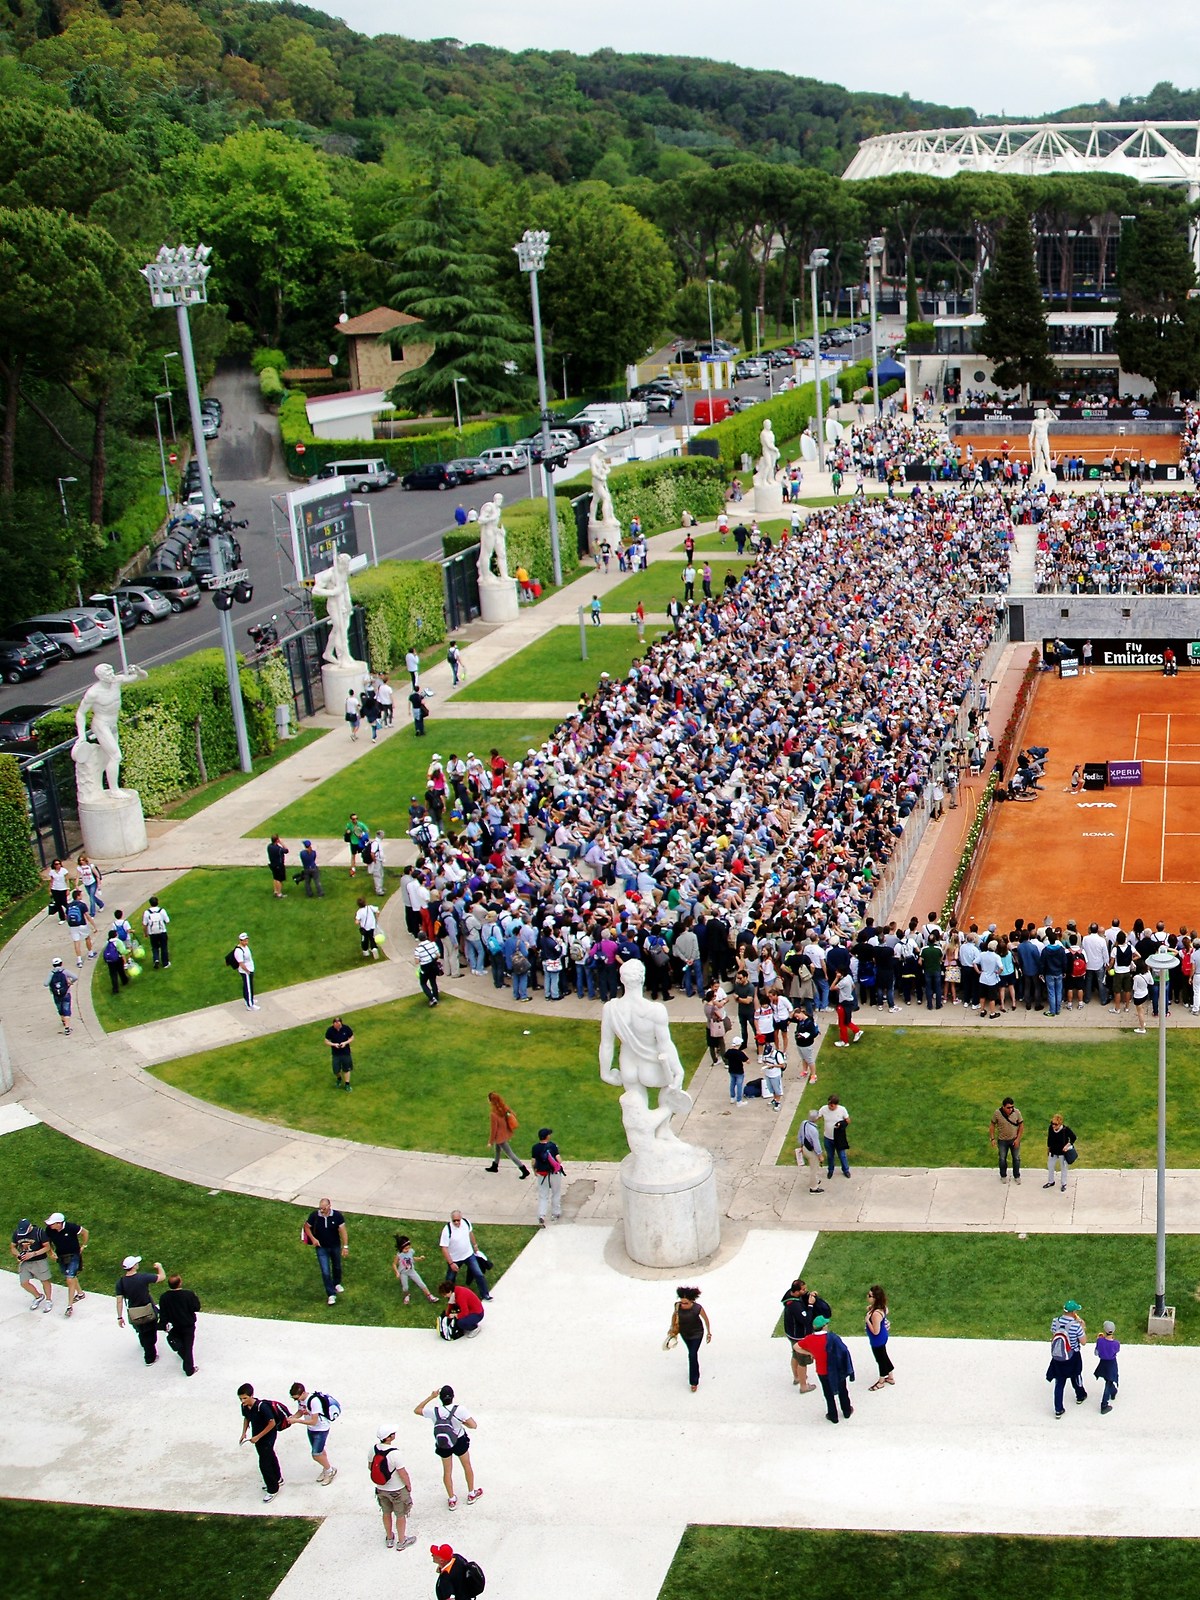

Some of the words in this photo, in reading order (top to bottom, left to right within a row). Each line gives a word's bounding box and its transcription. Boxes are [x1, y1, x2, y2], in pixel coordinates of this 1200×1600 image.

[984, 413, 1013, 421] Emirates
[1125, 642, 1142, 653] Fly
[1104, 651, 1164, 665] Emirates
